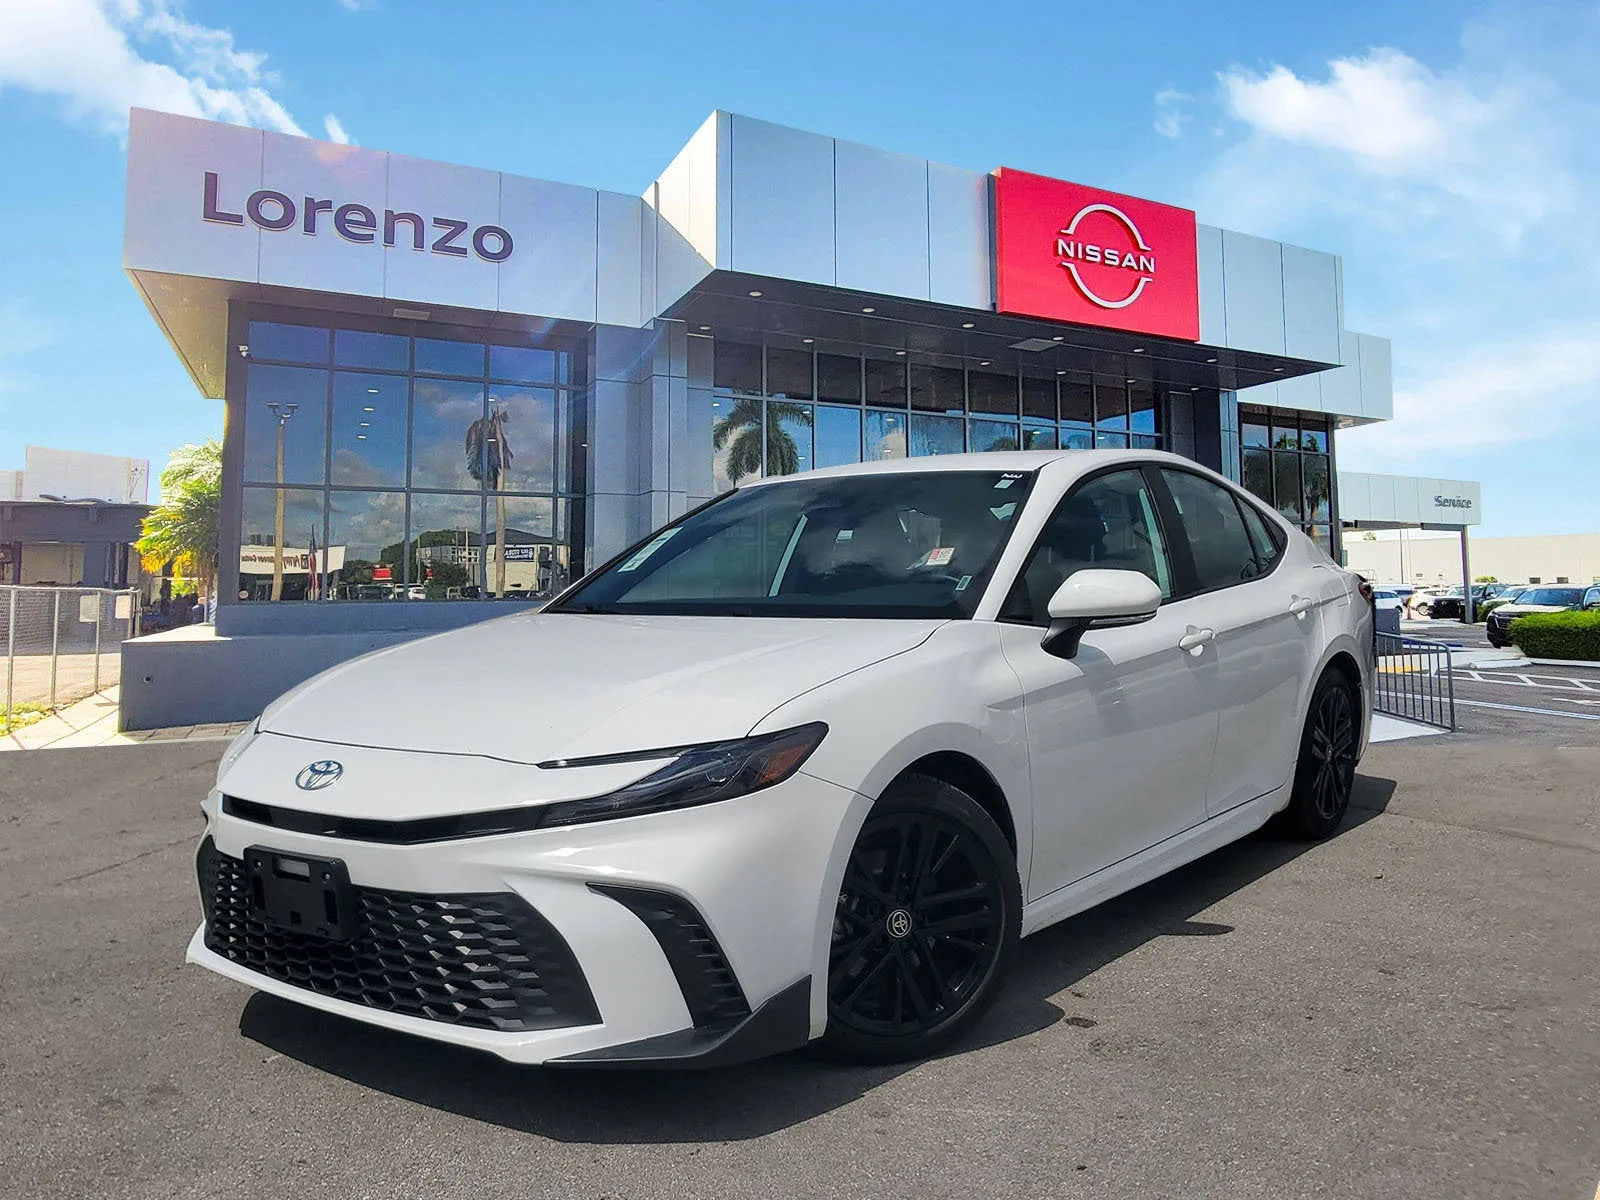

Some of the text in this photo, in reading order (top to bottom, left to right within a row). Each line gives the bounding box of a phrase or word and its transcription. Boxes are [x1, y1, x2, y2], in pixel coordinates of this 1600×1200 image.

[203, 172, 514, 262] Lorenzo
[1057, 238, 1155, 273] NISSAN
[1434, 495, 1472, 509] Service
